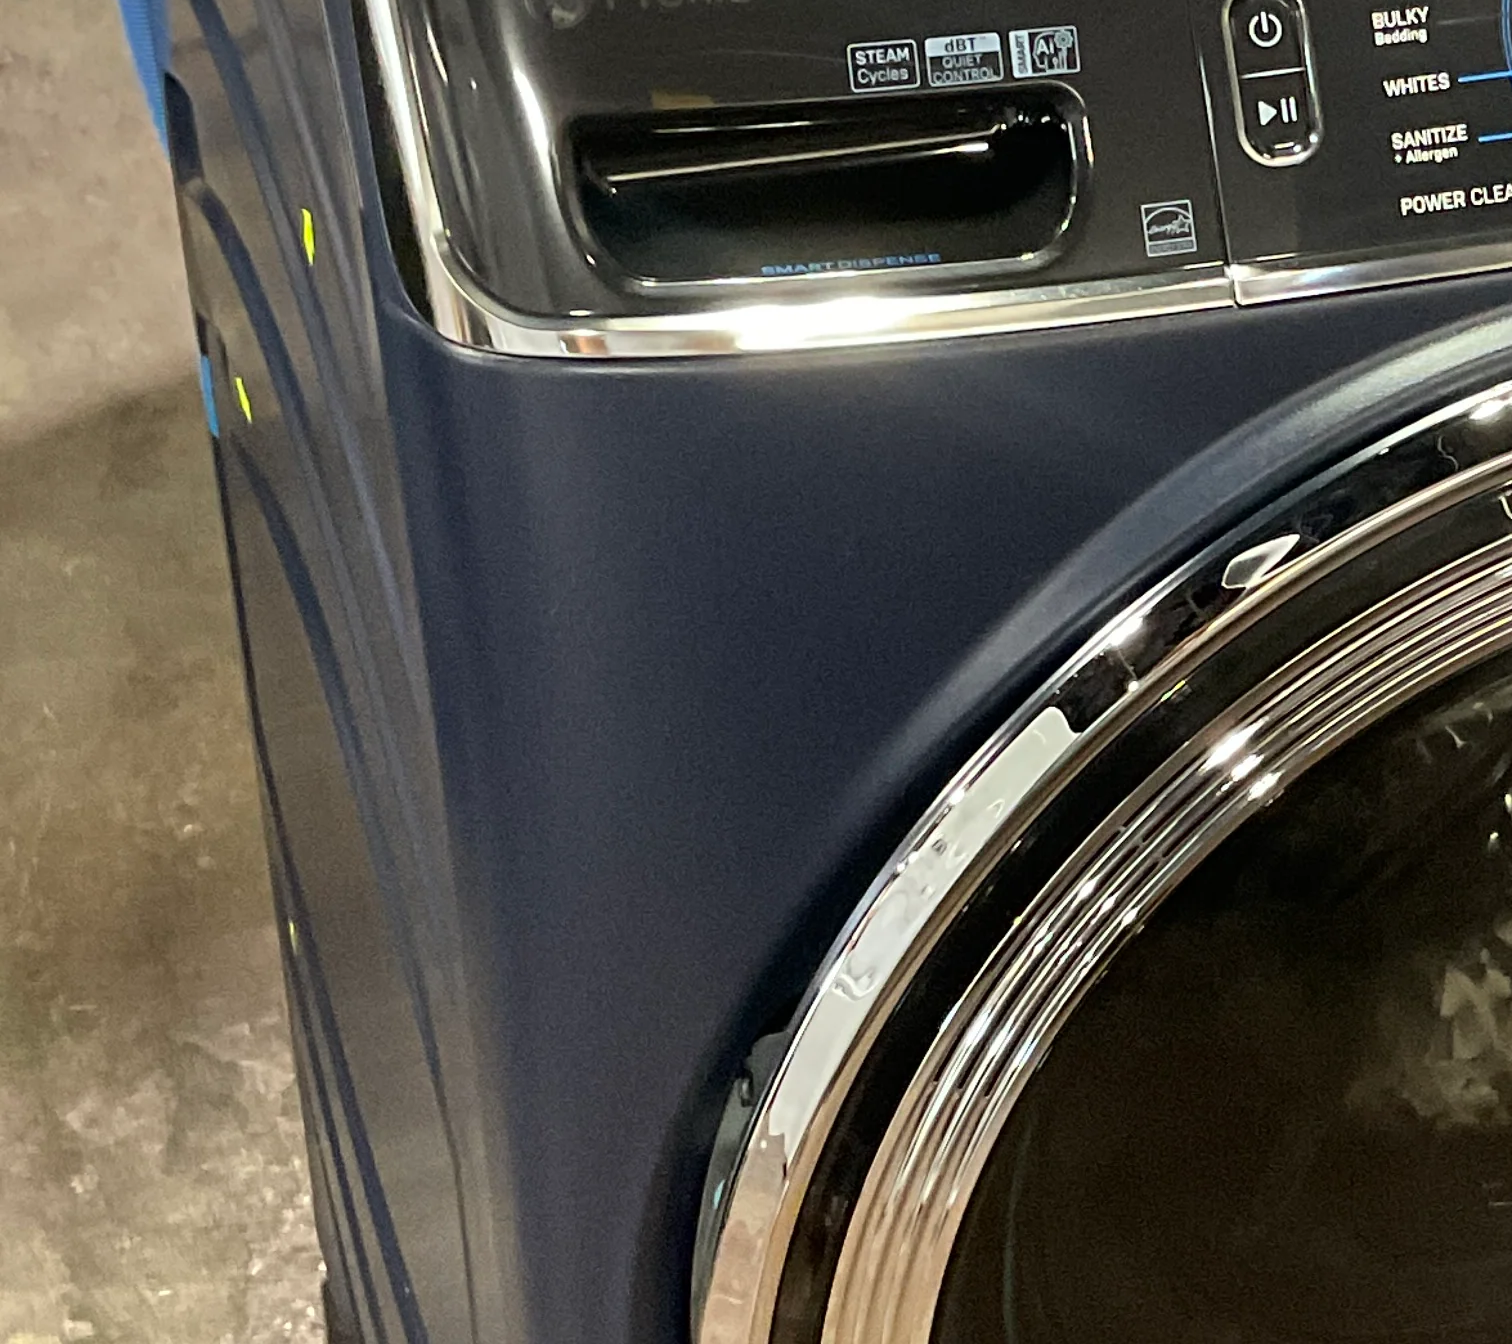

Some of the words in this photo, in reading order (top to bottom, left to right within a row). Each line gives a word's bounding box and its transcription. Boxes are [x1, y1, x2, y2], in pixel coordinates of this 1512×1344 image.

[1371, 6, 1429, 30] BULKY
[1037, 37, 1054, 55] AI
[1374, 28, 1428, 46] Bedding
[855, 46, 910, 66] STEAM
[942, 54, 983, 68] QUIET
[857, 66, 909, 86] Cycles
[931, 66, 995, 84] CONTROL
[1383, 72, 1450, 98] WHITES
[1391, 123, 1468, 150] SANITIZE
[1405, 146, 1458, 164] Allergen
[1400, 190, 1466, 216] POWER
